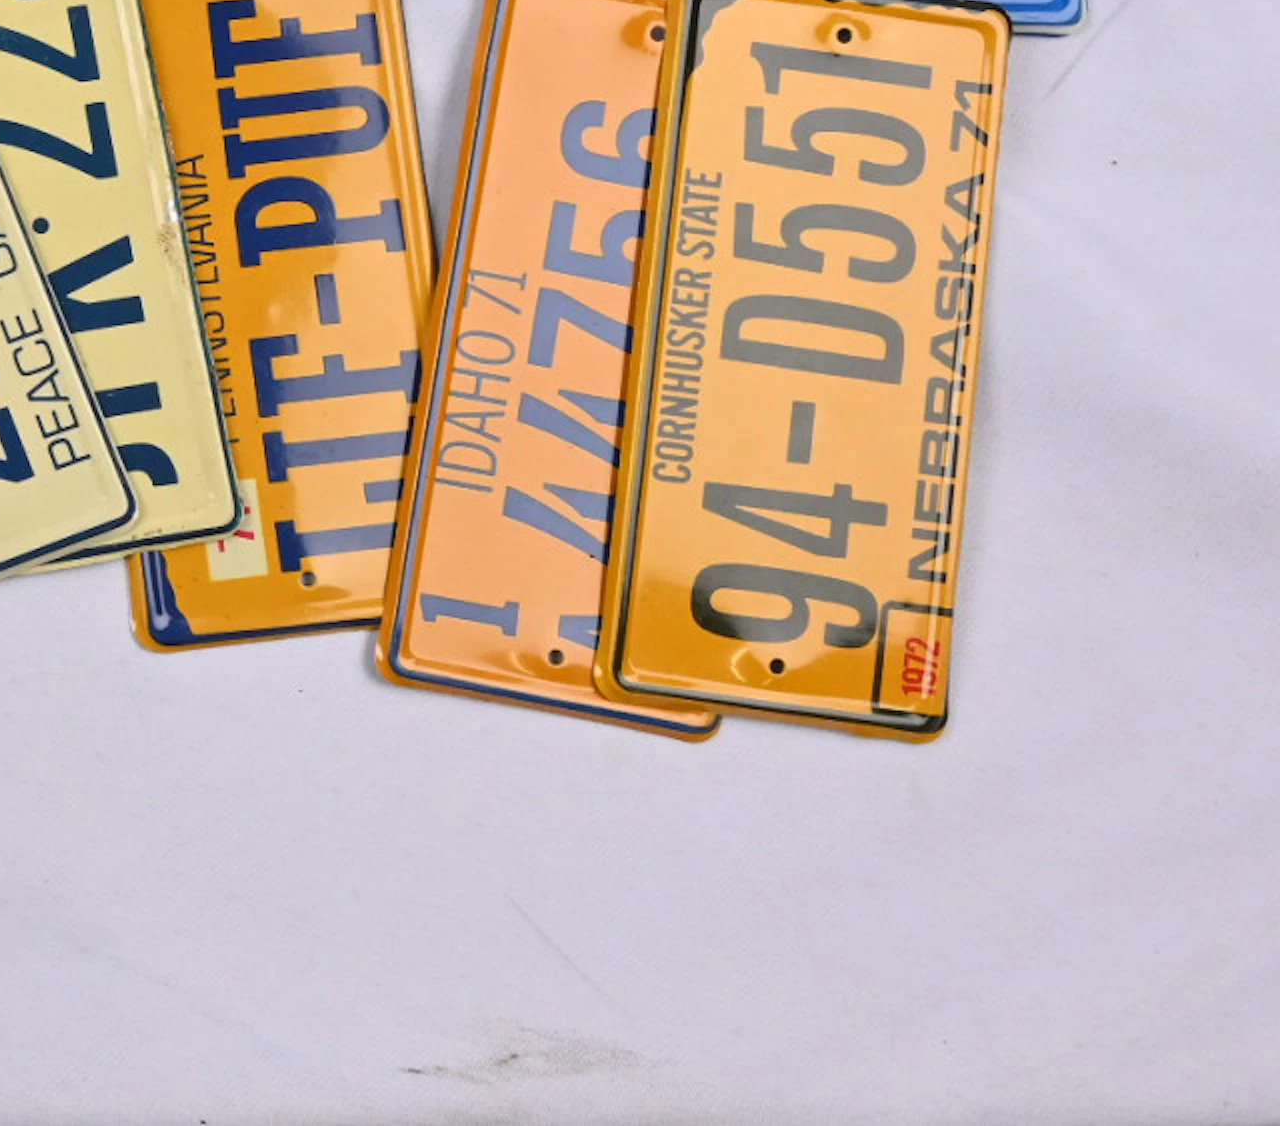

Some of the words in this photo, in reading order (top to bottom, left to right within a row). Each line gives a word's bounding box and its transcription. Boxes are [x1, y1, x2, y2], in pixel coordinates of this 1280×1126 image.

[466, 269, 527, 316] 71
[680, 168, 723, 266] STATE
[2, 308, 91, 469] PEACE
[434, 327, 518, 493] IDAHO
[651, 269, 717, 485] CORNHUSKER
[690, 42, 932, 648] 94-D551
[908, 173, 984, 583] NEBRASKA
[951, 80, 994, 152] 71
[420, 591, 520, 638] 1
[901, 636, 941, 698] 1972
